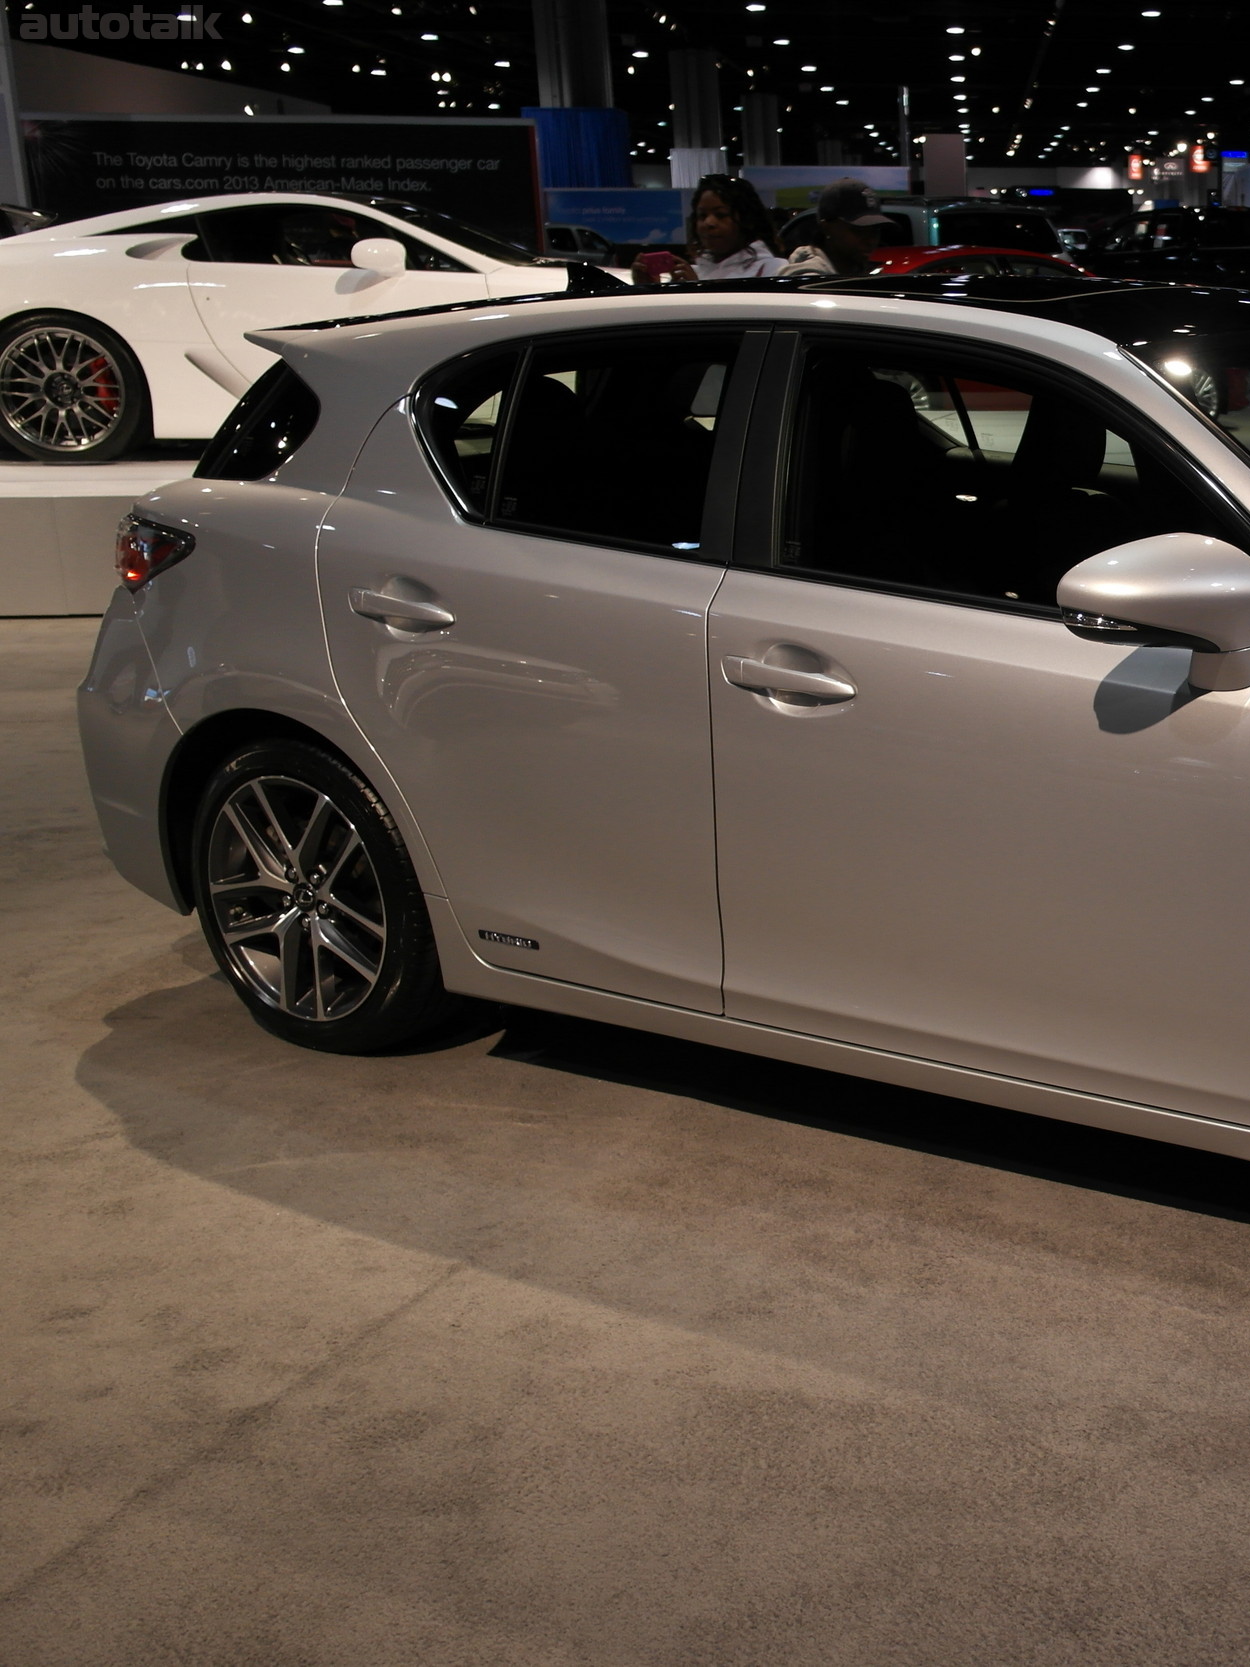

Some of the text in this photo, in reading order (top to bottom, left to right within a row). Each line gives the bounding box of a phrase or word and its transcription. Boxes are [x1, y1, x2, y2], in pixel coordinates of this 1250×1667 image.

[93, 152, 501, 173] The Toyota Camry is the highest ranked passenger car
[96, 177, 116, 189] on
[120, 175, 144, 189] the
[149, 177, 219, 190] cars.com
[223, 175, 259, 190] 2013
[264, 176, 384, 192] American-Made
